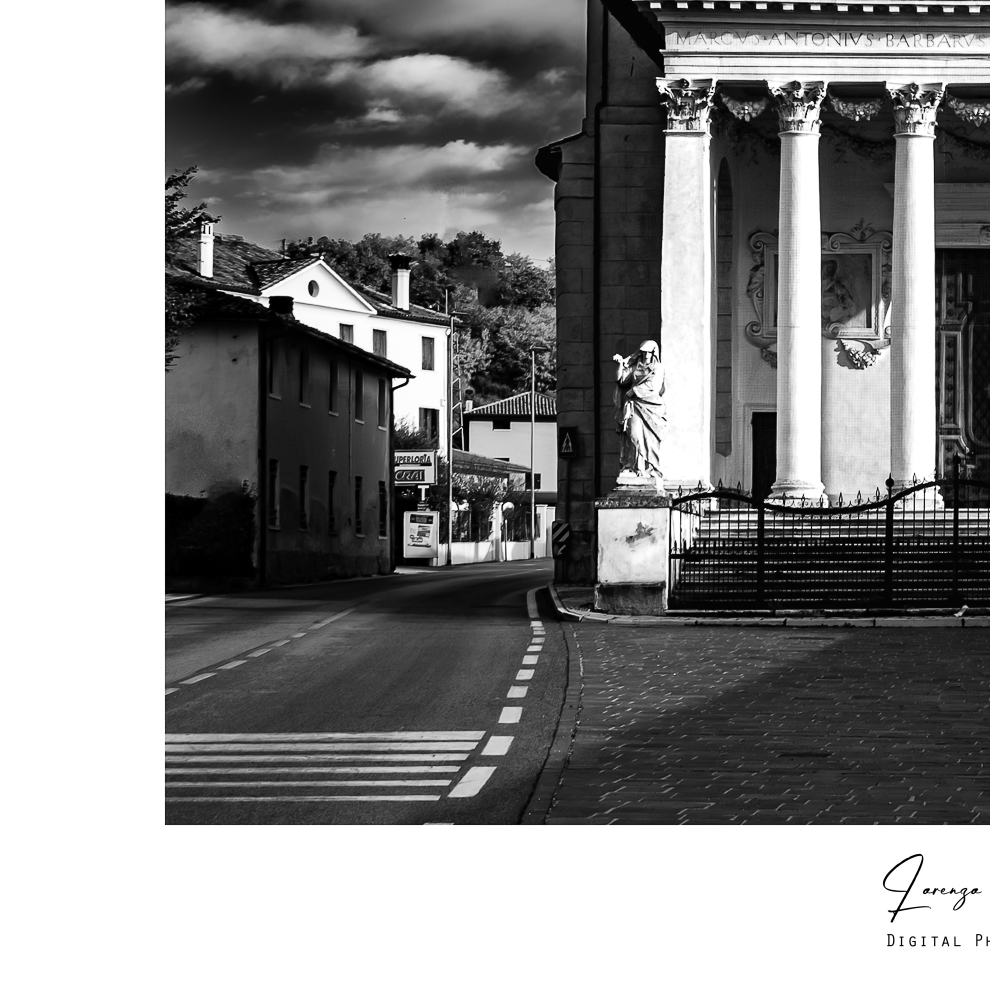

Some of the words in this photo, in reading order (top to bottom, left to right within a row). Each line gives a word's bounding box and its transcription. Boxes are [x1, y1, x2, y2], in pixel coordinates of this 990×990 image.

[675, 31, 760, 46] MARCVS
[768, 31, 874, 47] ANTONIVS
[885, 32, 985, 48] BARBARVS
